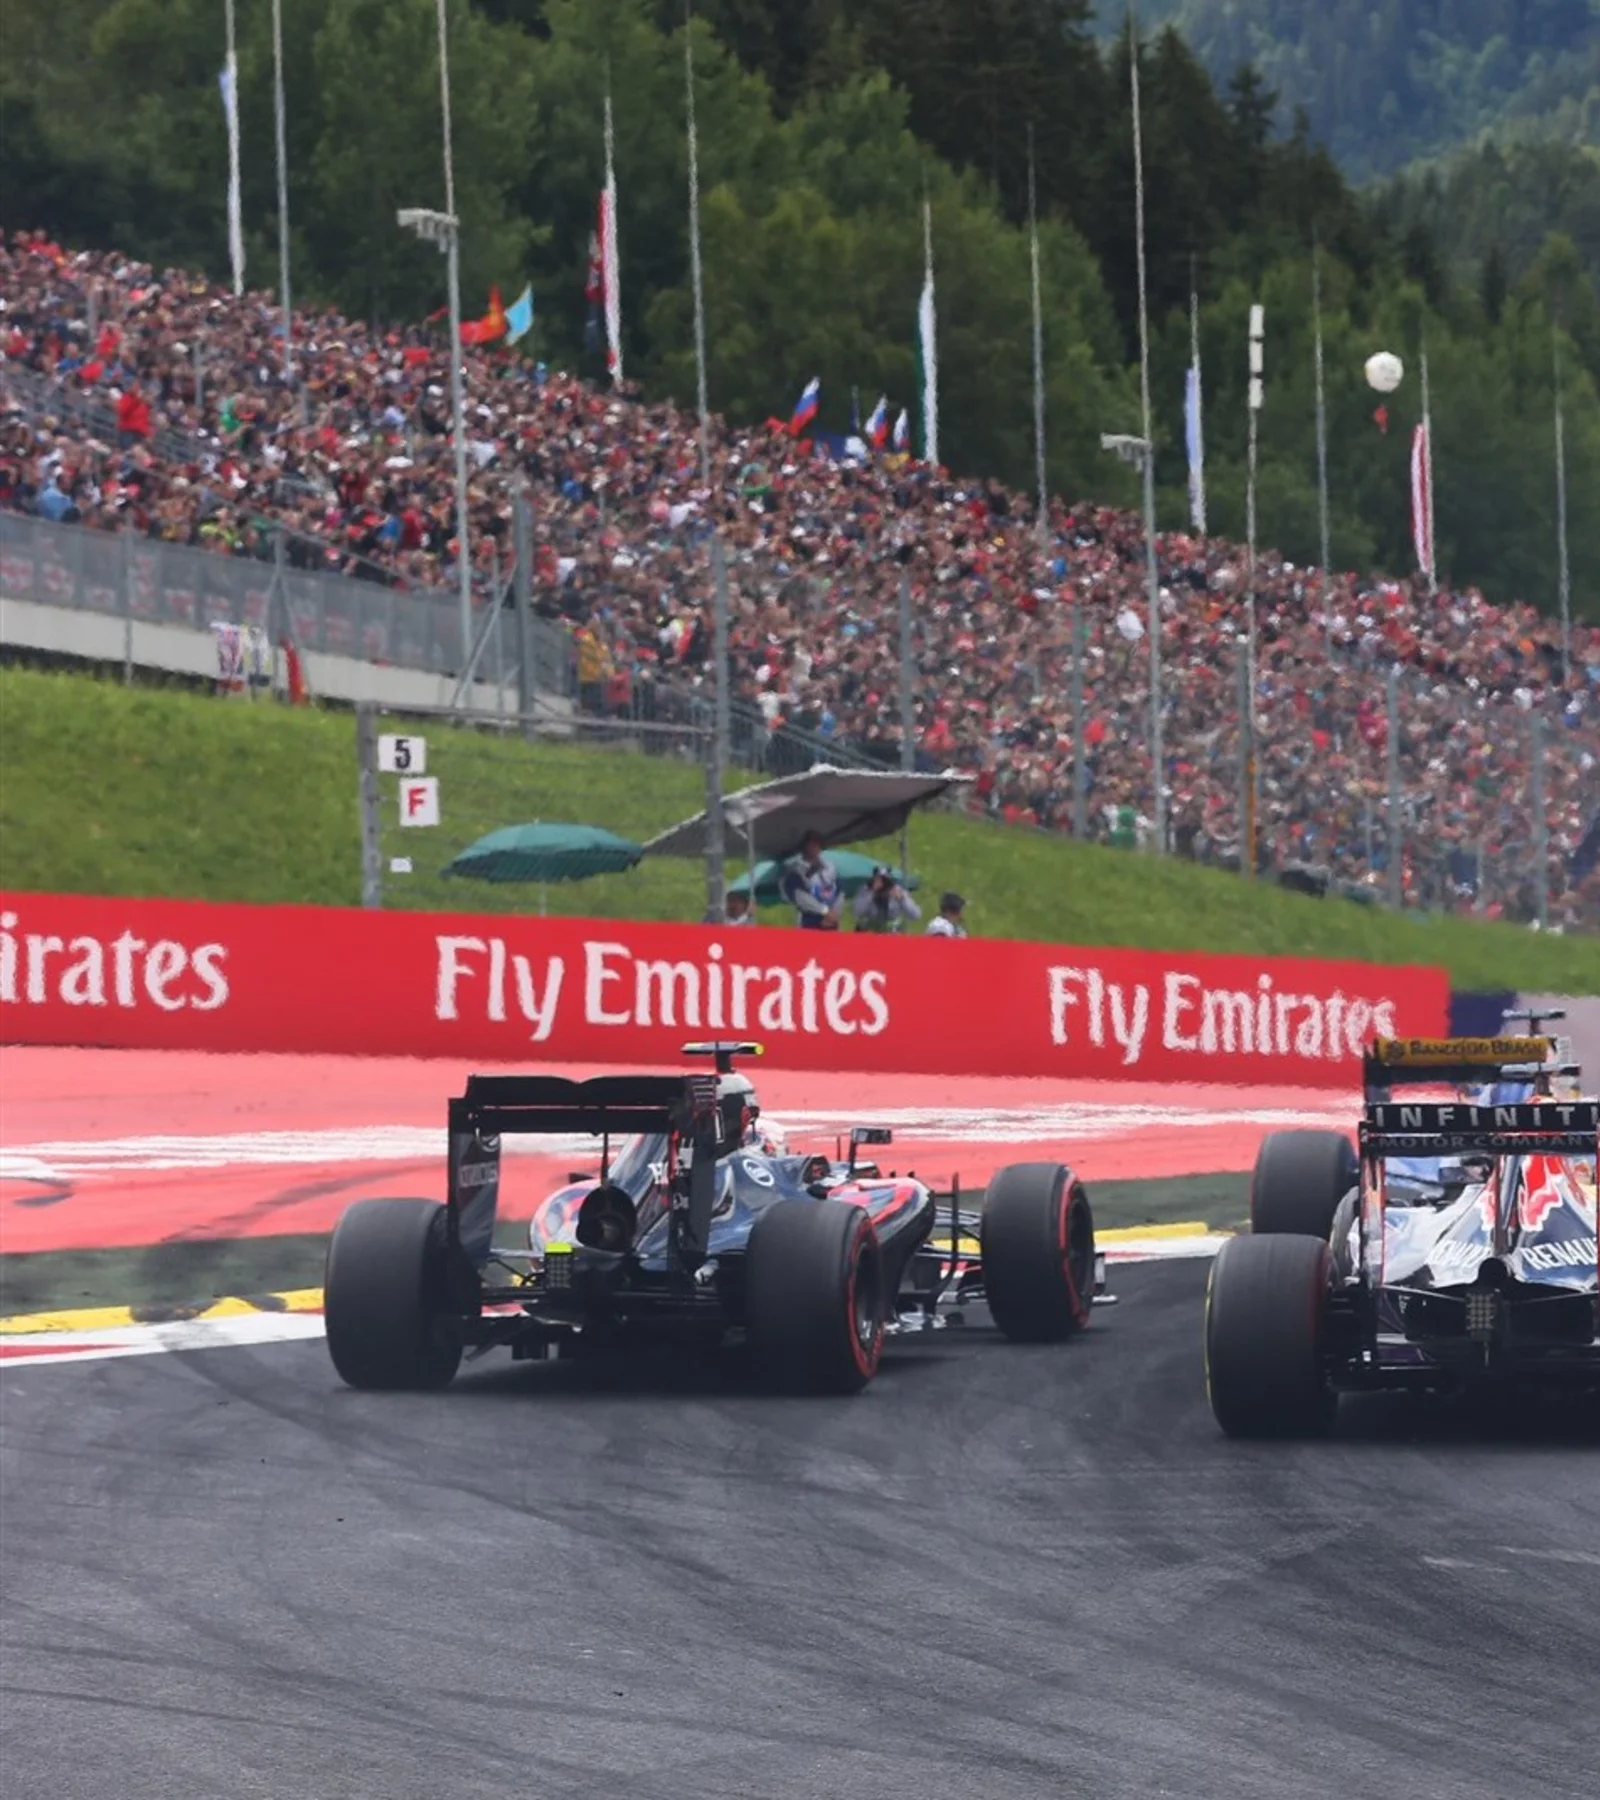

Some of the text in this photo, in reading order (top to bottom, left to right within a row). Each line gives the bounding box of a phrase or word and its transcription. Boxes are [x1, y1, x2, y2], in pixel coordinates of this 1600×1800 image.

[394, 739, 411, 769] 5
[408, 788, 427, 817] F
[435, 935, 889, 1041] Fly Emirates
[1047, 966, 1396, 1065] Fly Emirates
[1375, 1106, 1597, 1128] INFINITI
[1378, 1135, 1464, 1149] MOTOR
